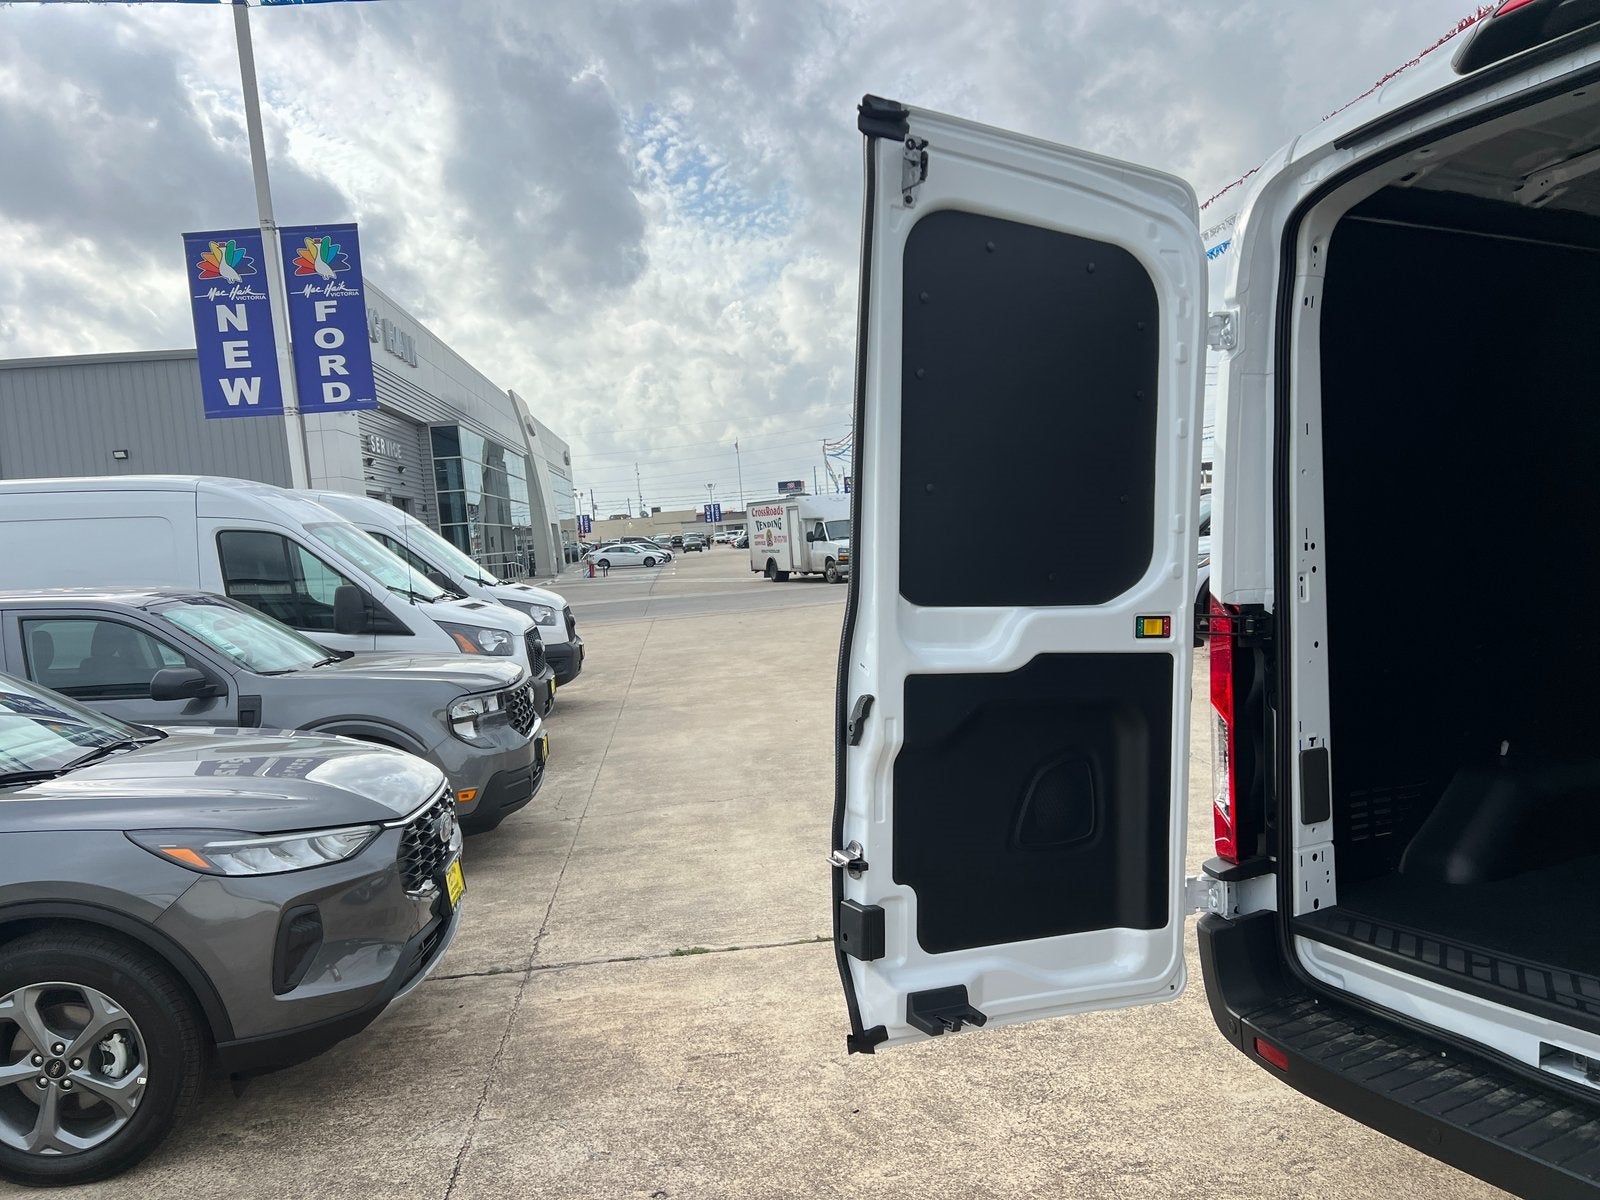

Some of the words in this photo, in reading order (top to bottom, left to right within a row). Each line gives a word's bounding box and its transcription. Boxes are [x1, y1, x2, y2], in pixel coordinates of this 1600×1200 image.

[198, 287, 229, 301] Mac
[229, 284, 261, 300] Haik
[294, 284, 324, 298] Mac
[324, 281, 354, 297] Haik
[215, 303, 261, 406] NEW
[314, 300, 351, 403] FORD
[370, 434, 402, 459] SERVICE
[752, 505, 784, 517] CrossRoads
